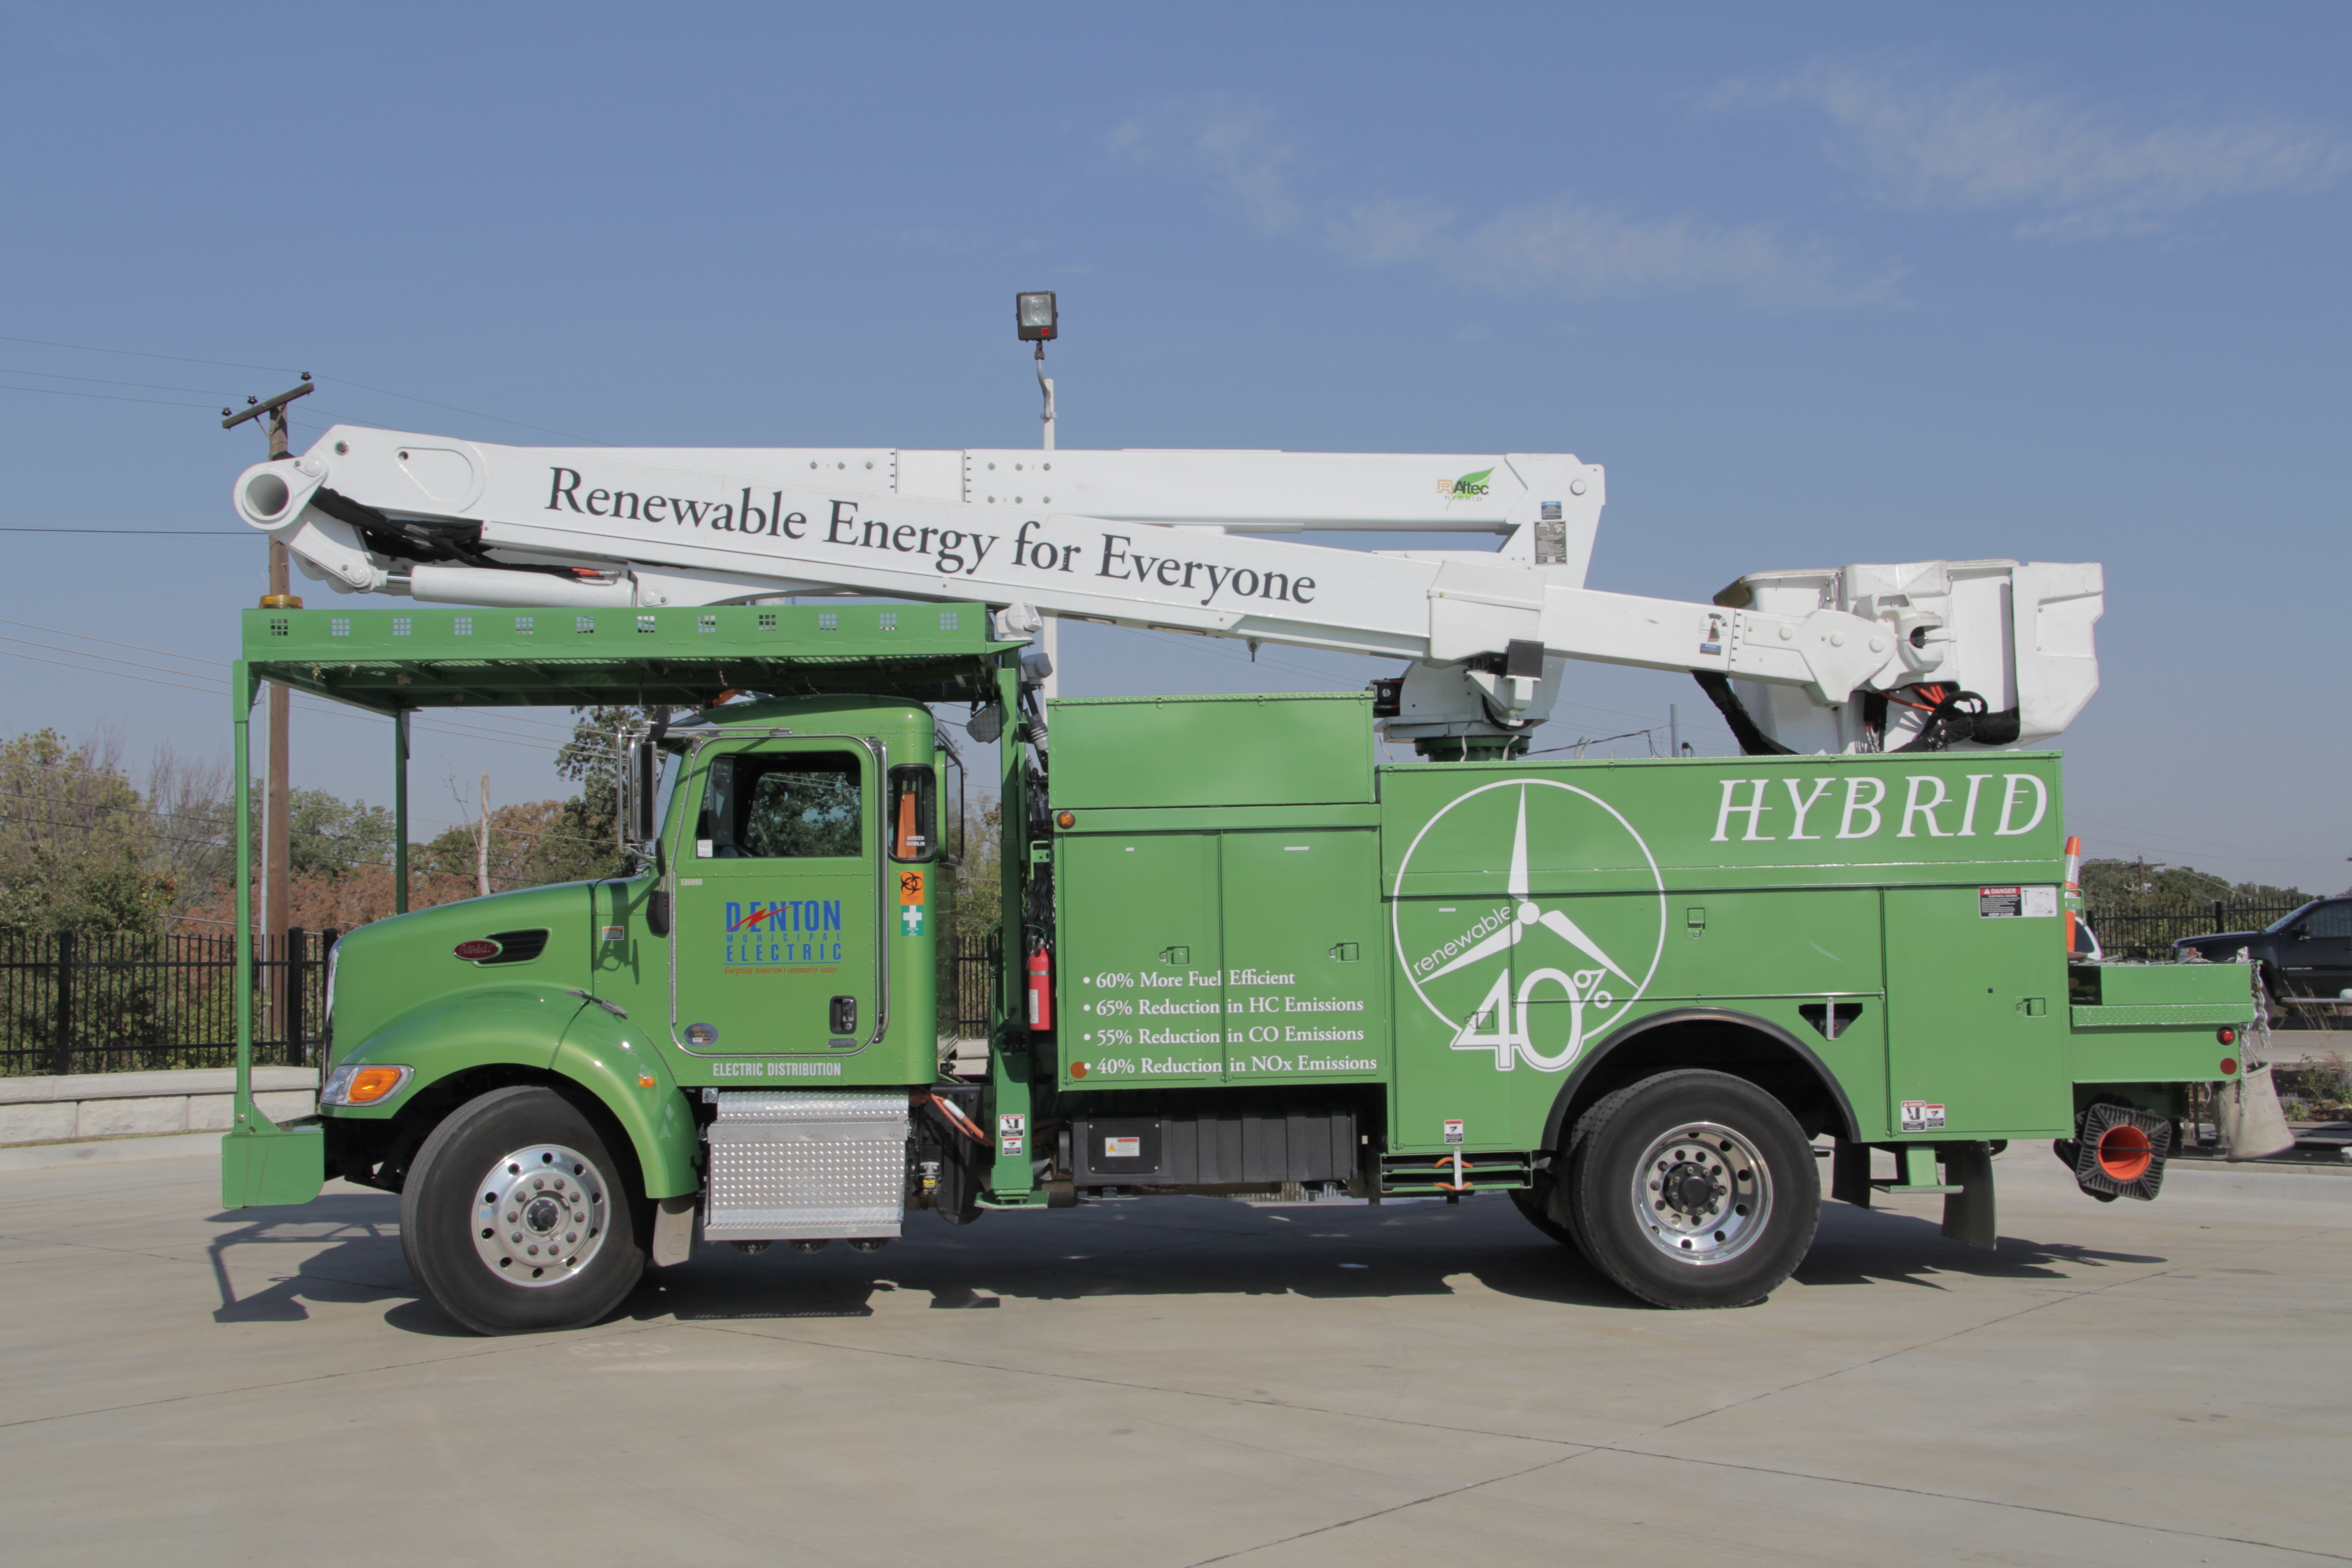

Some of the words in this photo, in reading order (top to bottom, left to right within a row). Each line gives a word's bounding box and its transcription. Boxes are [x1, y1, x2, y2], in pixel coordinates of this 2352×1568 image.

[1454, 480, 1489, 495] Altec
[545, 467, 807, 539] Renewable
[823, 500, 1000, 575] Energy
[1011, 521, 1081, 572] for
[1095, 534, 1316, 605] Everyone
[1710, 773, 2048, 842] HYBRID
[726, 900, 841, 933] DENTON
[726, 932, 841, 943] MUNICIPAL
[1413, 906, 1512, 976] renewable
[459, 944, 495, 955] Peterbilt
[726, 943, 841, 962] ELECTRIC
[723, 966, 753, 975] Energizing
[819, 965, 838, 974] today!
[1096, 972, 1134, 988] 60%
[1140, 972, 1183, 987] More
[1188, 970, 1221, 986] Fuel
[1229, 968, 1295, 985] Efficient
[1096, 1000, 1132, 1016] 65%
[1138, 998, 1220, 1014] Reduction
[1227, 997, 1244, 1013] in
[1249, 996, 1279, 1013] HC
[1284, 996, 1364, 1012] Emissions
[1450, 967, 1613, 1072] 40%
[1097, 1029, 1133, 1046] 55%
[1138, 1027, 1220, 1044] Reduction
[1227, 1028, 1244, 1043] in
[1249, 1026, 1279, 1042] CO
[1284, 1026, 1364, 1041] Emissions
[713, 1063, 763, 1076] ELECTRIC
[768, 1063, 841, 1076] DISTRIBUTION
[1097, 1058, 1135, 1074] 40%
[1141, 1057, 1223, 1073] Reduction
[1230, 1058, 1246, 1072] in
[1251, 1055, 1293, 1072] NOx
[1297, 1055, 1377, 1071] Emissions
